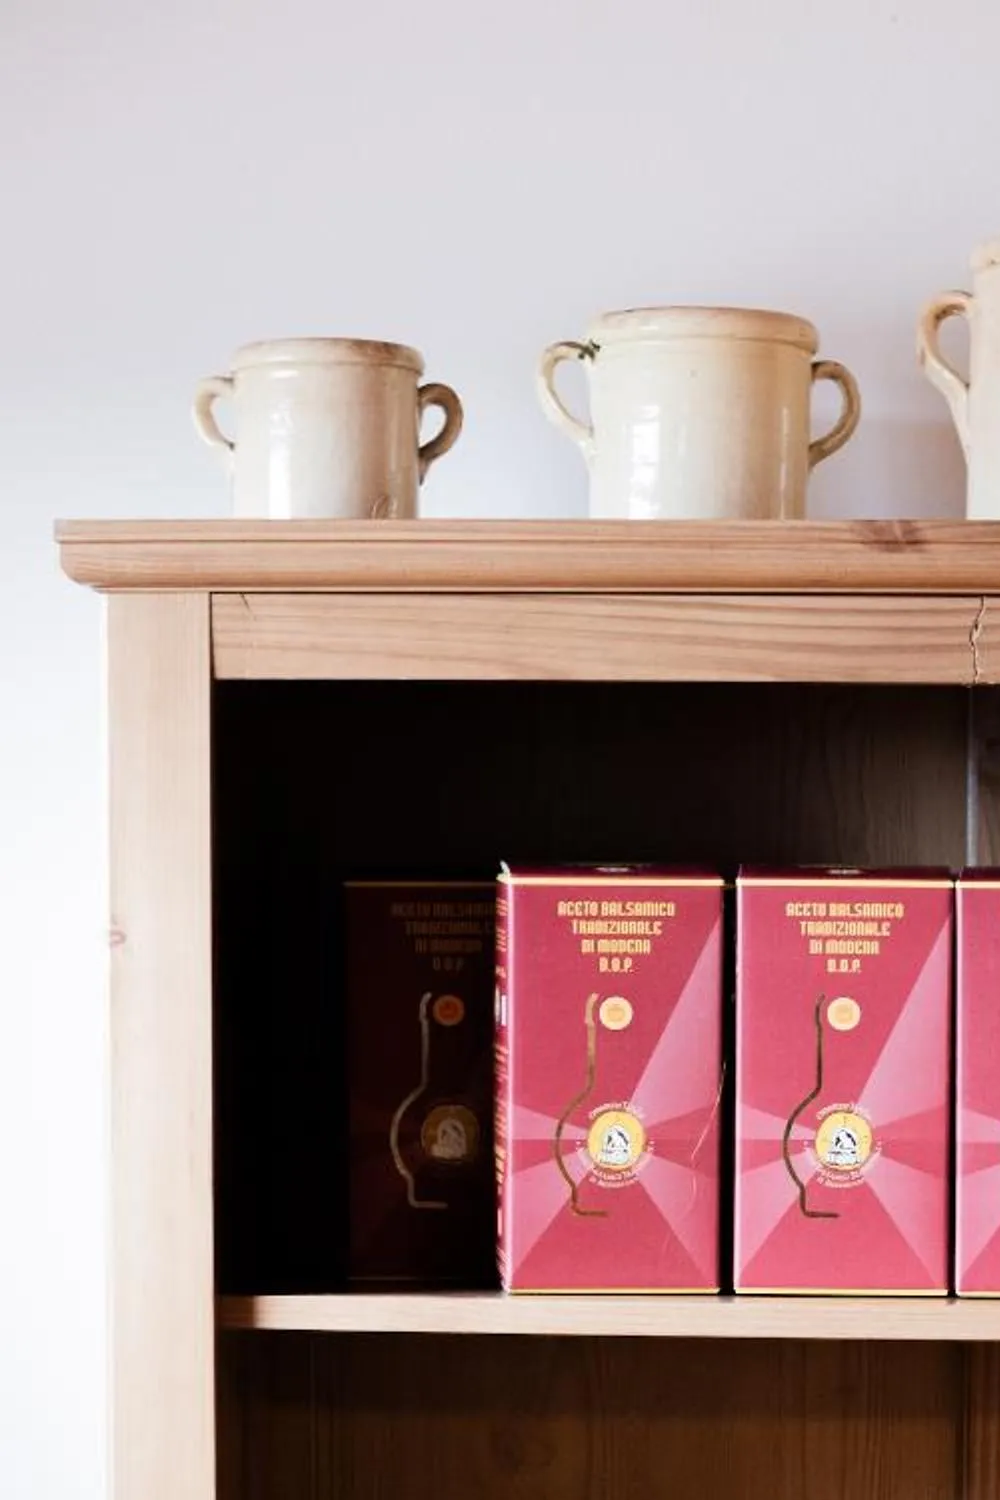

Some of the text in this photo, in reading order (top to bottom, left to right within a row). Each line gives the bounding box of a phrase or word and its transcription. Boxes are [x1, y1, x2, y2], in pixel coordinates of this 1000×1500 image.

[557, 901, 675, 916] ACETO BALSAMICO
[786, 902, 905, 918] ACETO BALSAMICO
